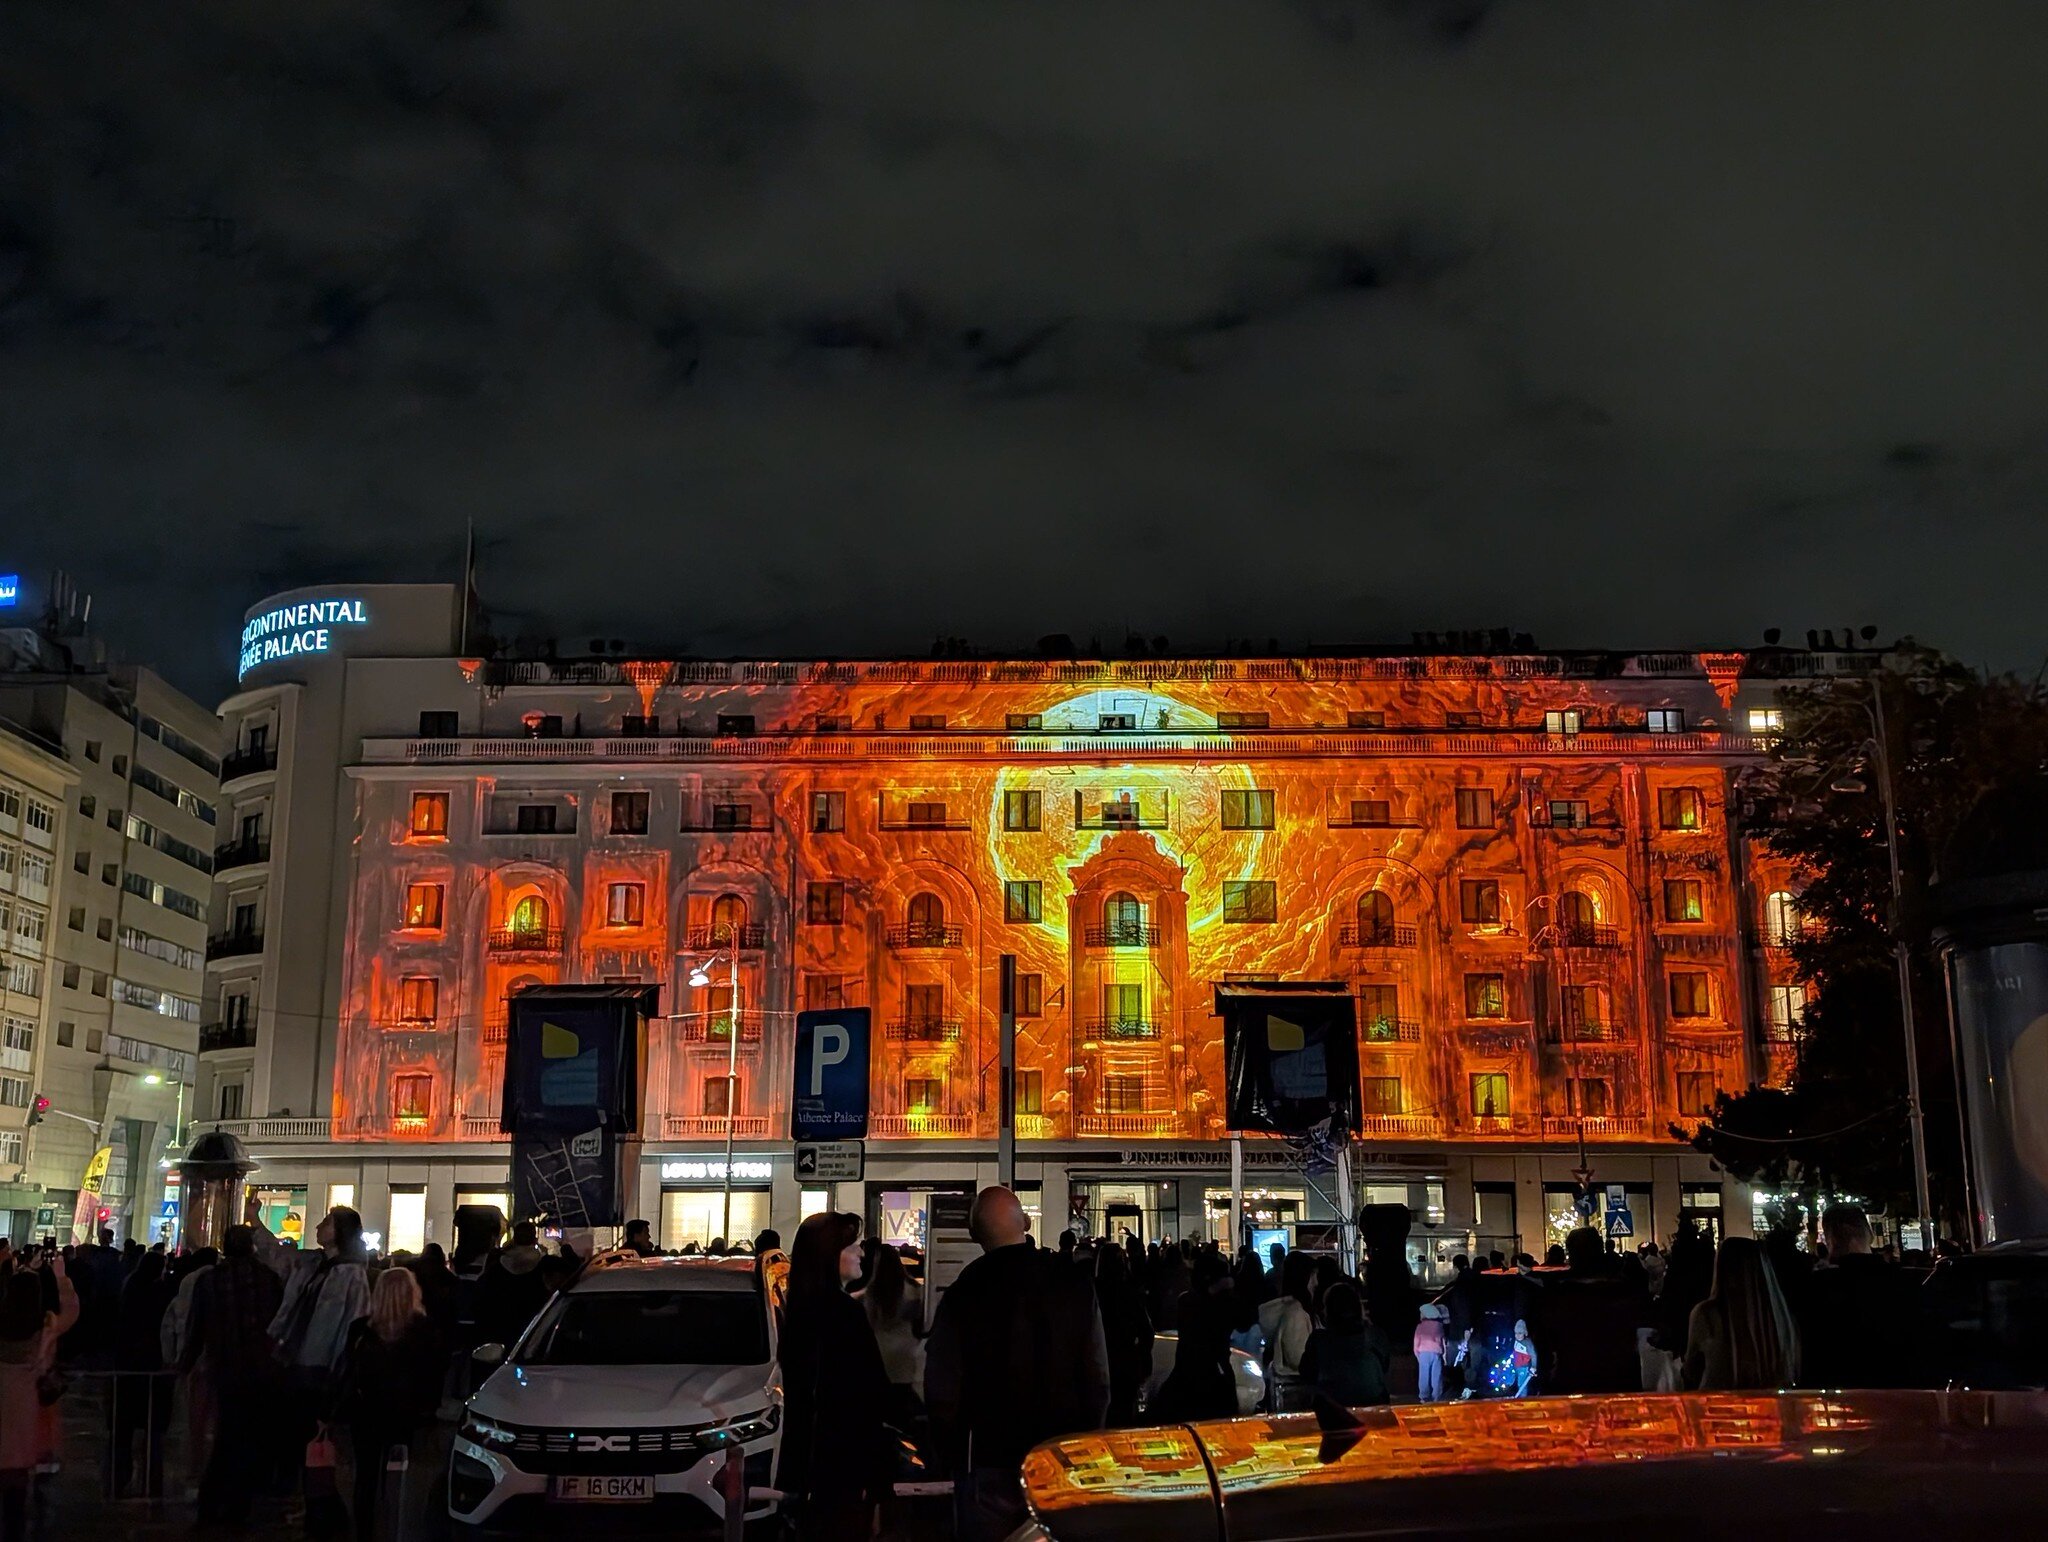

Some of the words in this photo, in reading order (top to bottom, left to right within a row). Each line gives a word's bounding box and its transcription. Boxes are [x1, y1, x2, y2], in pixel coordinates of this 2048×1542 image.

[264, 629, 329, 661] PALACE
[811, 1024, 850, 1096] P
[834, 1111, 864, 1123] Palace
[1135, 1151, 1277, 1165] INTERCONTINNTAL
[662, 1162, 707, 1178] LOUIS
[587, 1478, 602, 1495] 16
[607, 1478, 645, 1496] GKM
